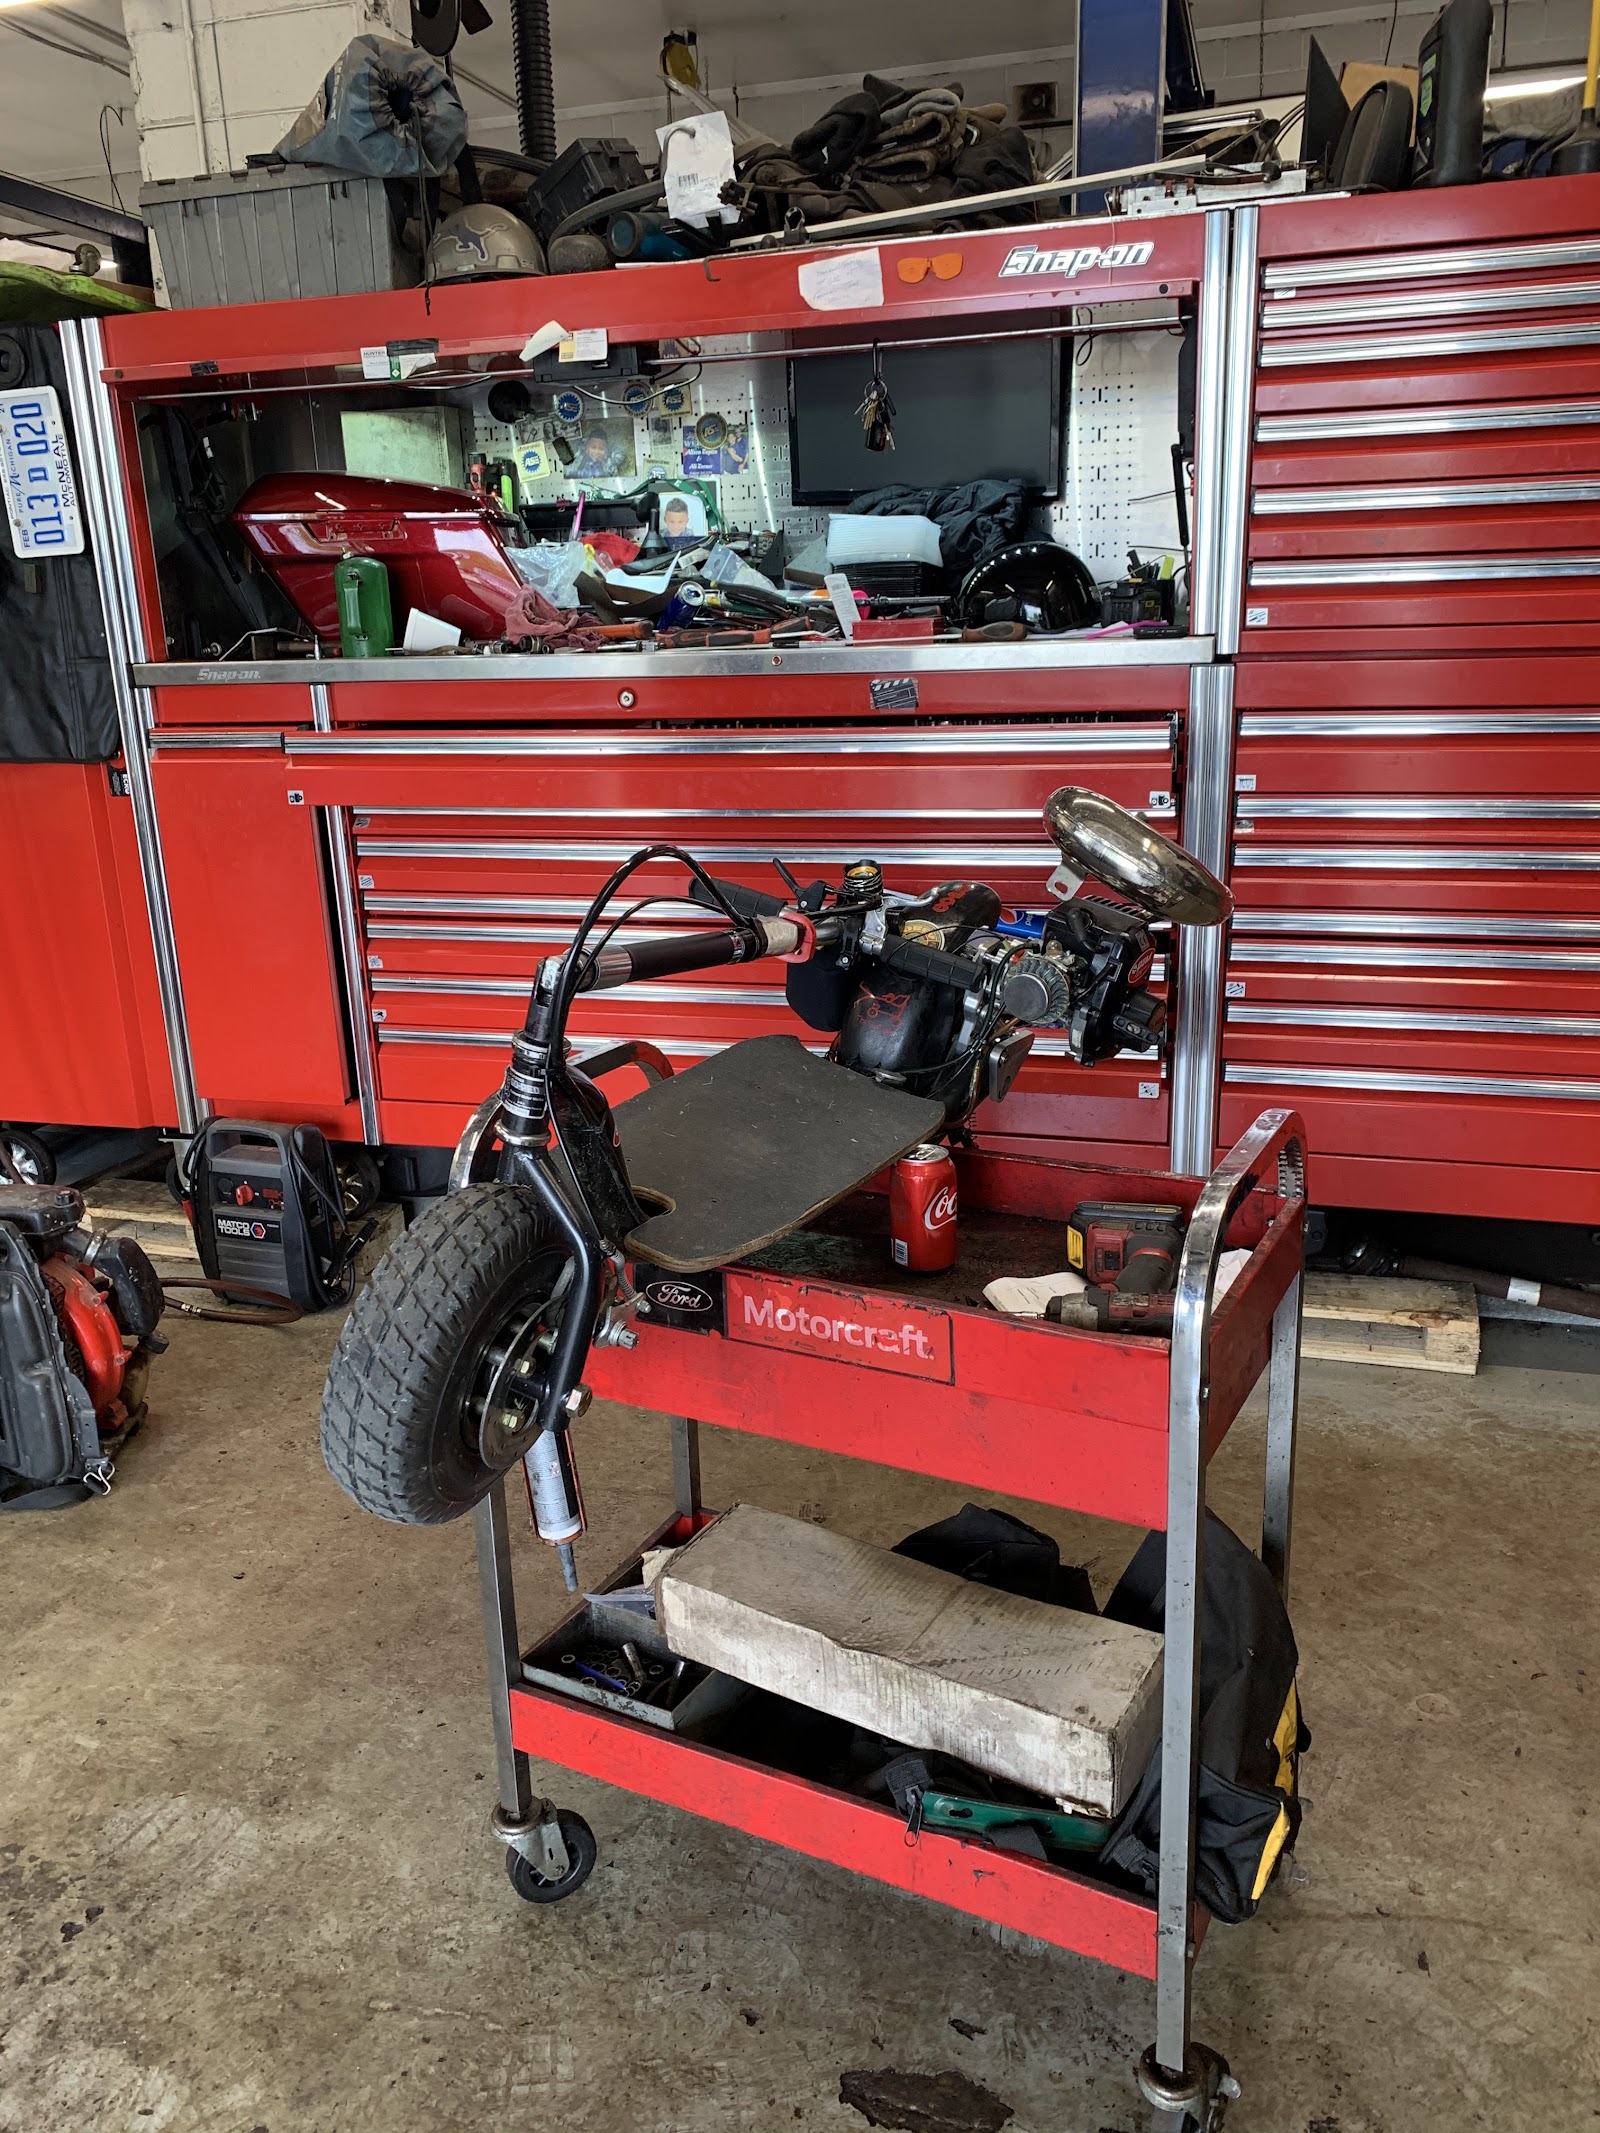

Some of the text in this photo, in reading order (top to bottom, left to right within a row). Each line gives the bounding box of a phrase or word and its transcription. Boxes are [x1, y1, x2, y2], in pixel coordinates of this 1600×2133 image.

[998, 242, 1154, 278] Snap-on
[58, 433, 76, 507] AUTOMOTIVE
[524, 455, 540, 467] ASE
[10, 402, 66, 545] 013 D 020
[16, 492, 24, 513] PURE
[22, 529, 31, 548] FEB
[218, 1219, 250, 1230] MATCO
[218, 1226, 250, 1236] TOOLS
[657, 1284, 702, 1308] Ford
[743, 1295, 934, 1361] Motorcraft
